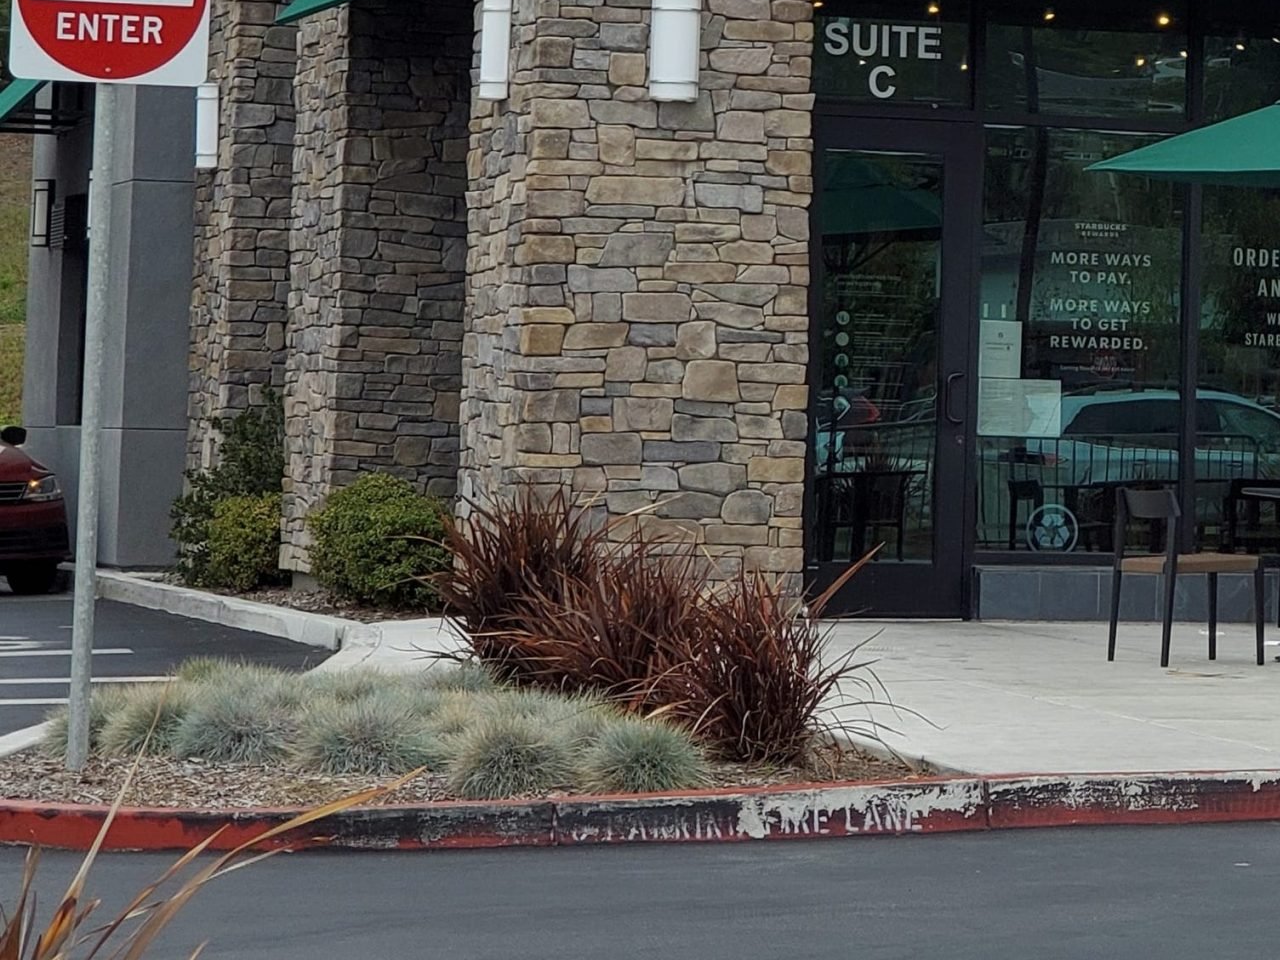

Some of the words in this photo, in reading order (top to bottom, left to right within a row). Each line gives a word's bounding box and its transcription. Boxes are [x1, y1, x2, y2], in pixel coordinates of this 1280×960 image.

[56, 12, 163, 44] ENTER
[824, 22, 942, 59] SUITE
[868, 65, 896, 99] C
[1051, 252, 1099, 265] MORE
[1105, 253, 1152, 267] WAYS
[1070, 271, 1091, 283] TO
[1097, 272, 1131, 285] PAY.
[1050, 299, 1098, 312] MORE
[1103, 300, 1151, 314] WAYS
[1071, 318, 1092, 330] TO
[1098, 319, 1128, 331] GET
[1050, 336, 1148, 350] REWARDED.
